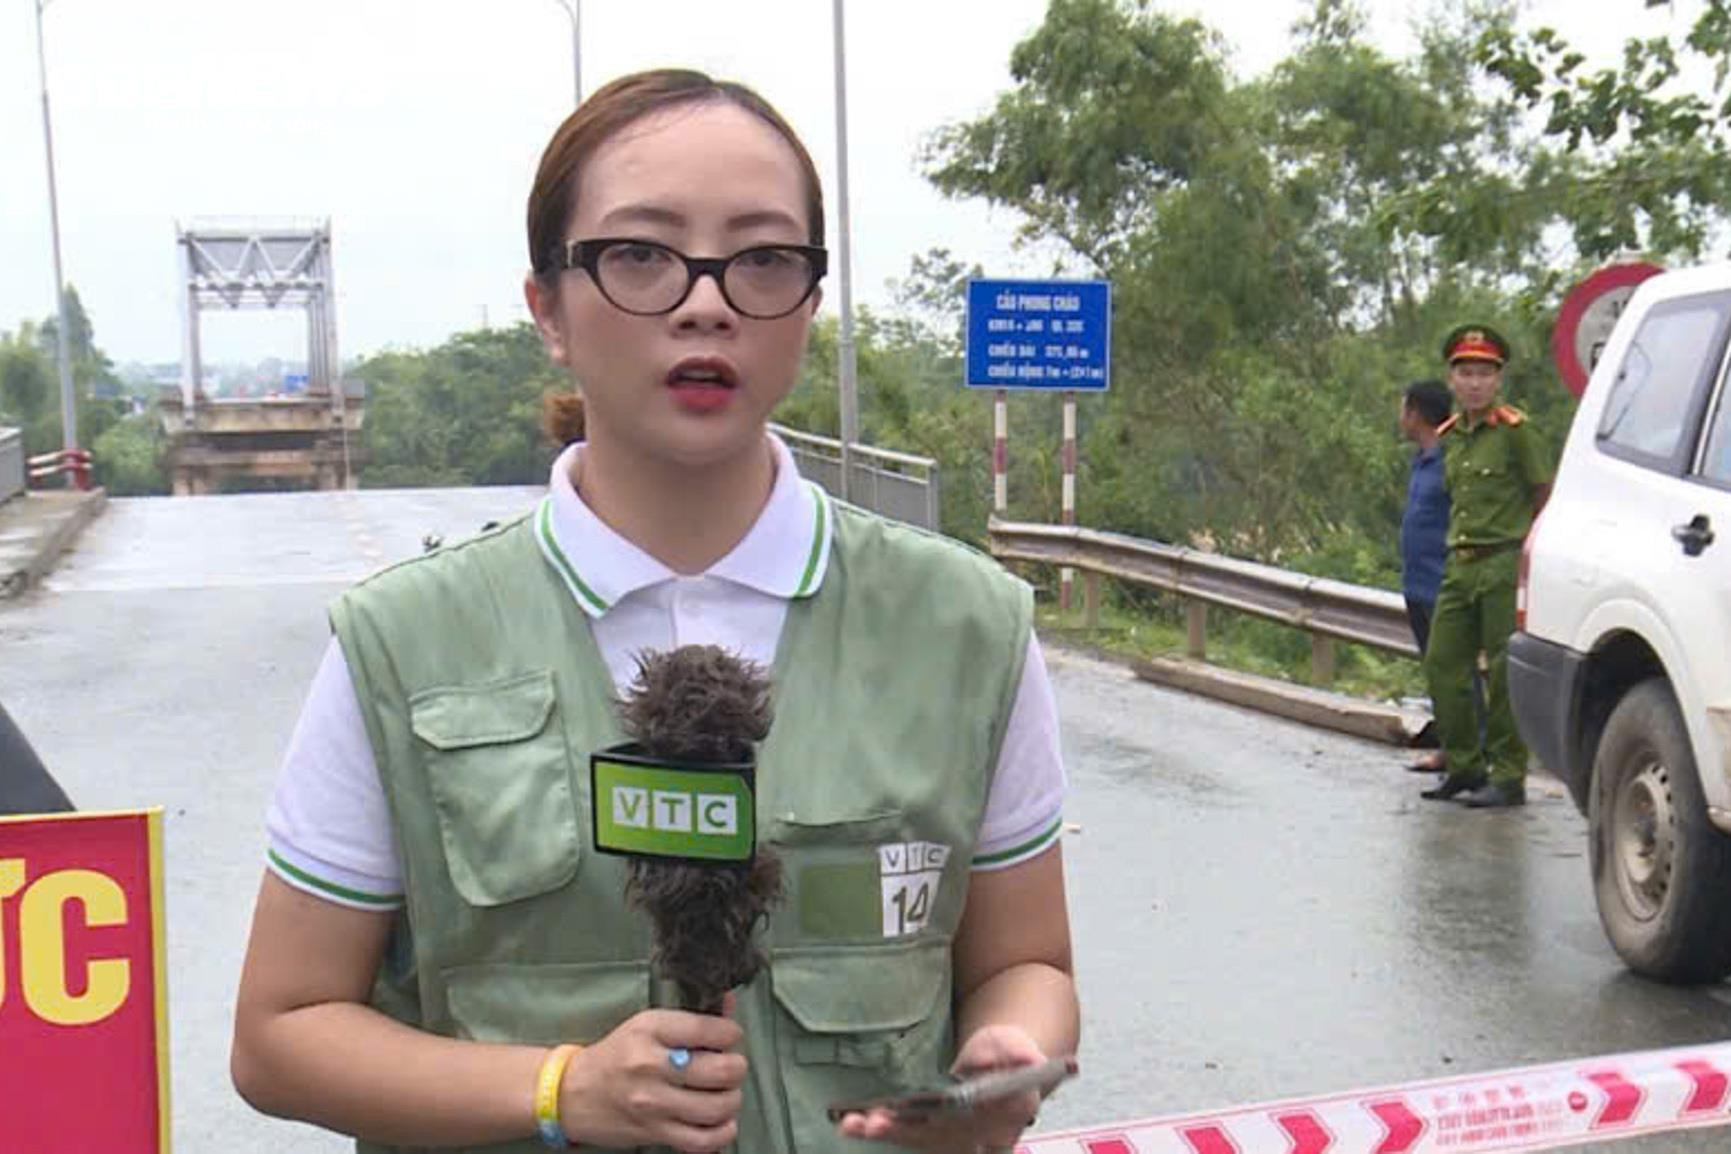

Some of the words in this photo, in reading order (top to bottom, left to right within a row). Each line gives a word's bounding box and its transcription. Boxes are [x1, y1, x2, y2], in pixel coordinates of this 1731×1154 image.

[619, 790, 728, 828] VTC
[885, 846, 943, 867] VTC
[892, 881, 928, 933] 14
